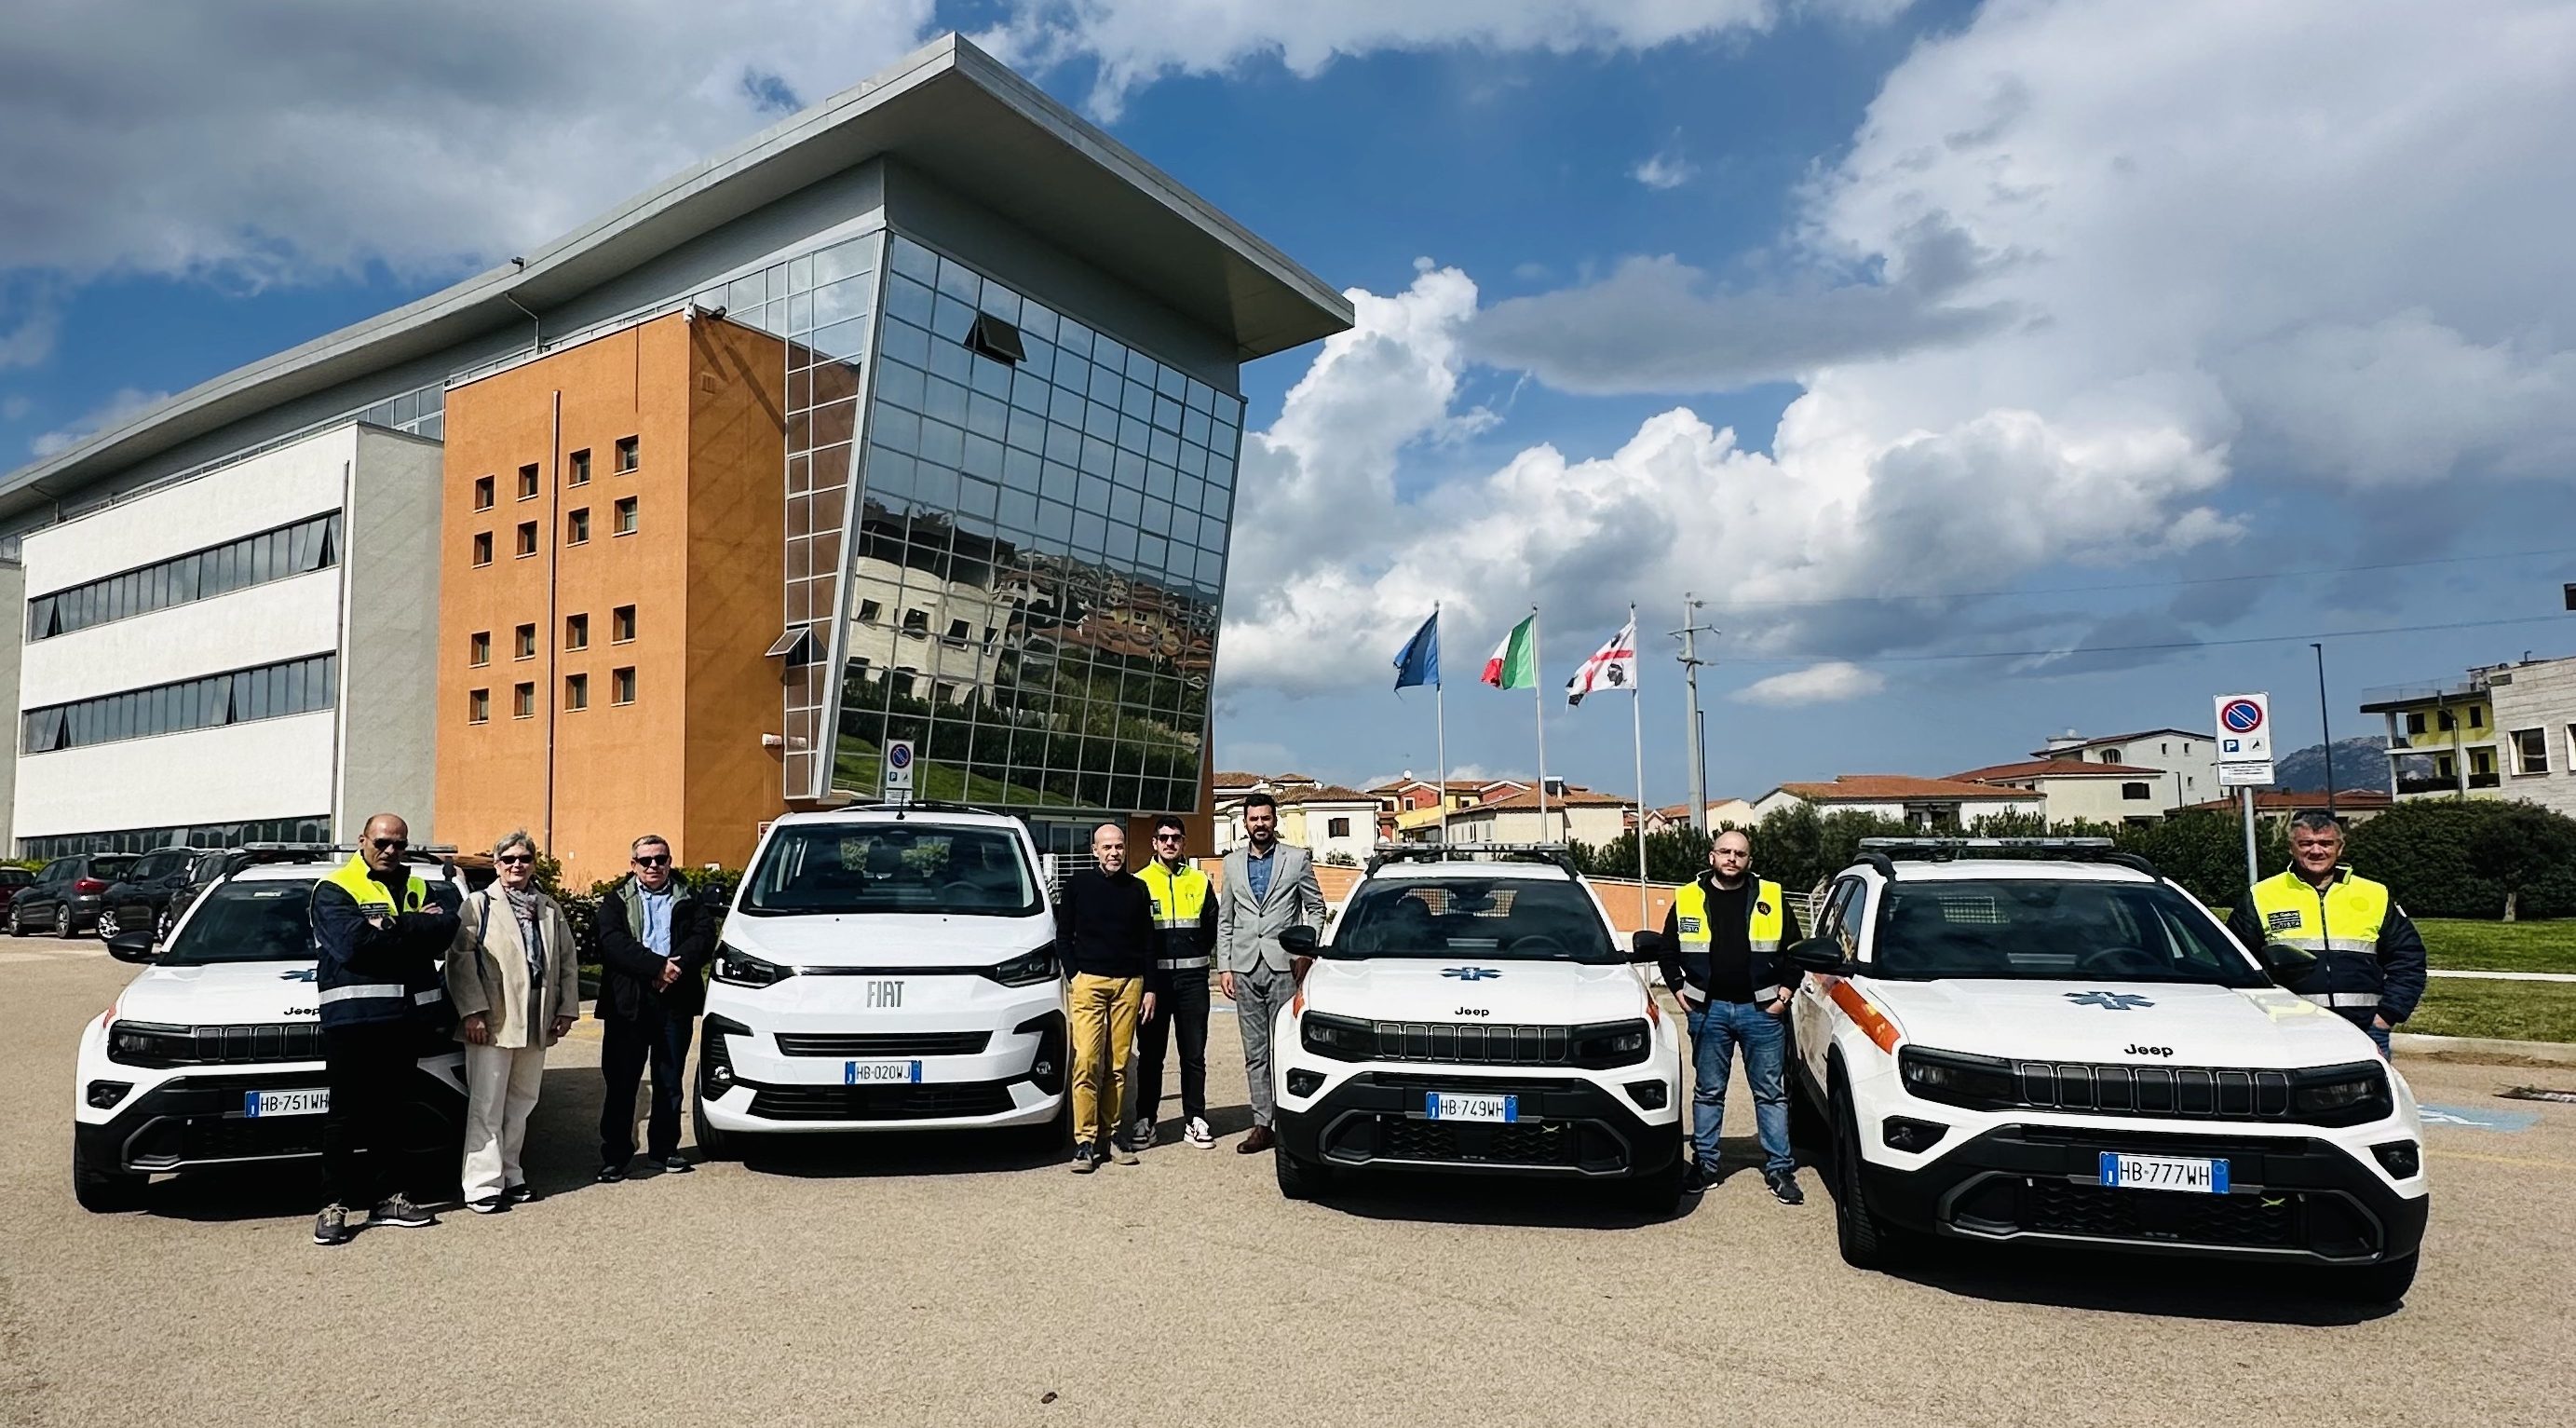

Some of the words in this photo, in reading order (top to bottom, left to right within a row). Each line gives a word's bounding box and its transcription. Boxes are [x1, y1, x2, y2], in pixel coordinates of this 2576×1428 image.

[2226, 741, 2237, 752] P
[866, 980, 905, 1008] FIAT
[283, 1007, 321, 1016] Jeep
[1454, 1006, 1490, 1017] Jeep
[2123, 1043, 2175, 1058] Jeep
